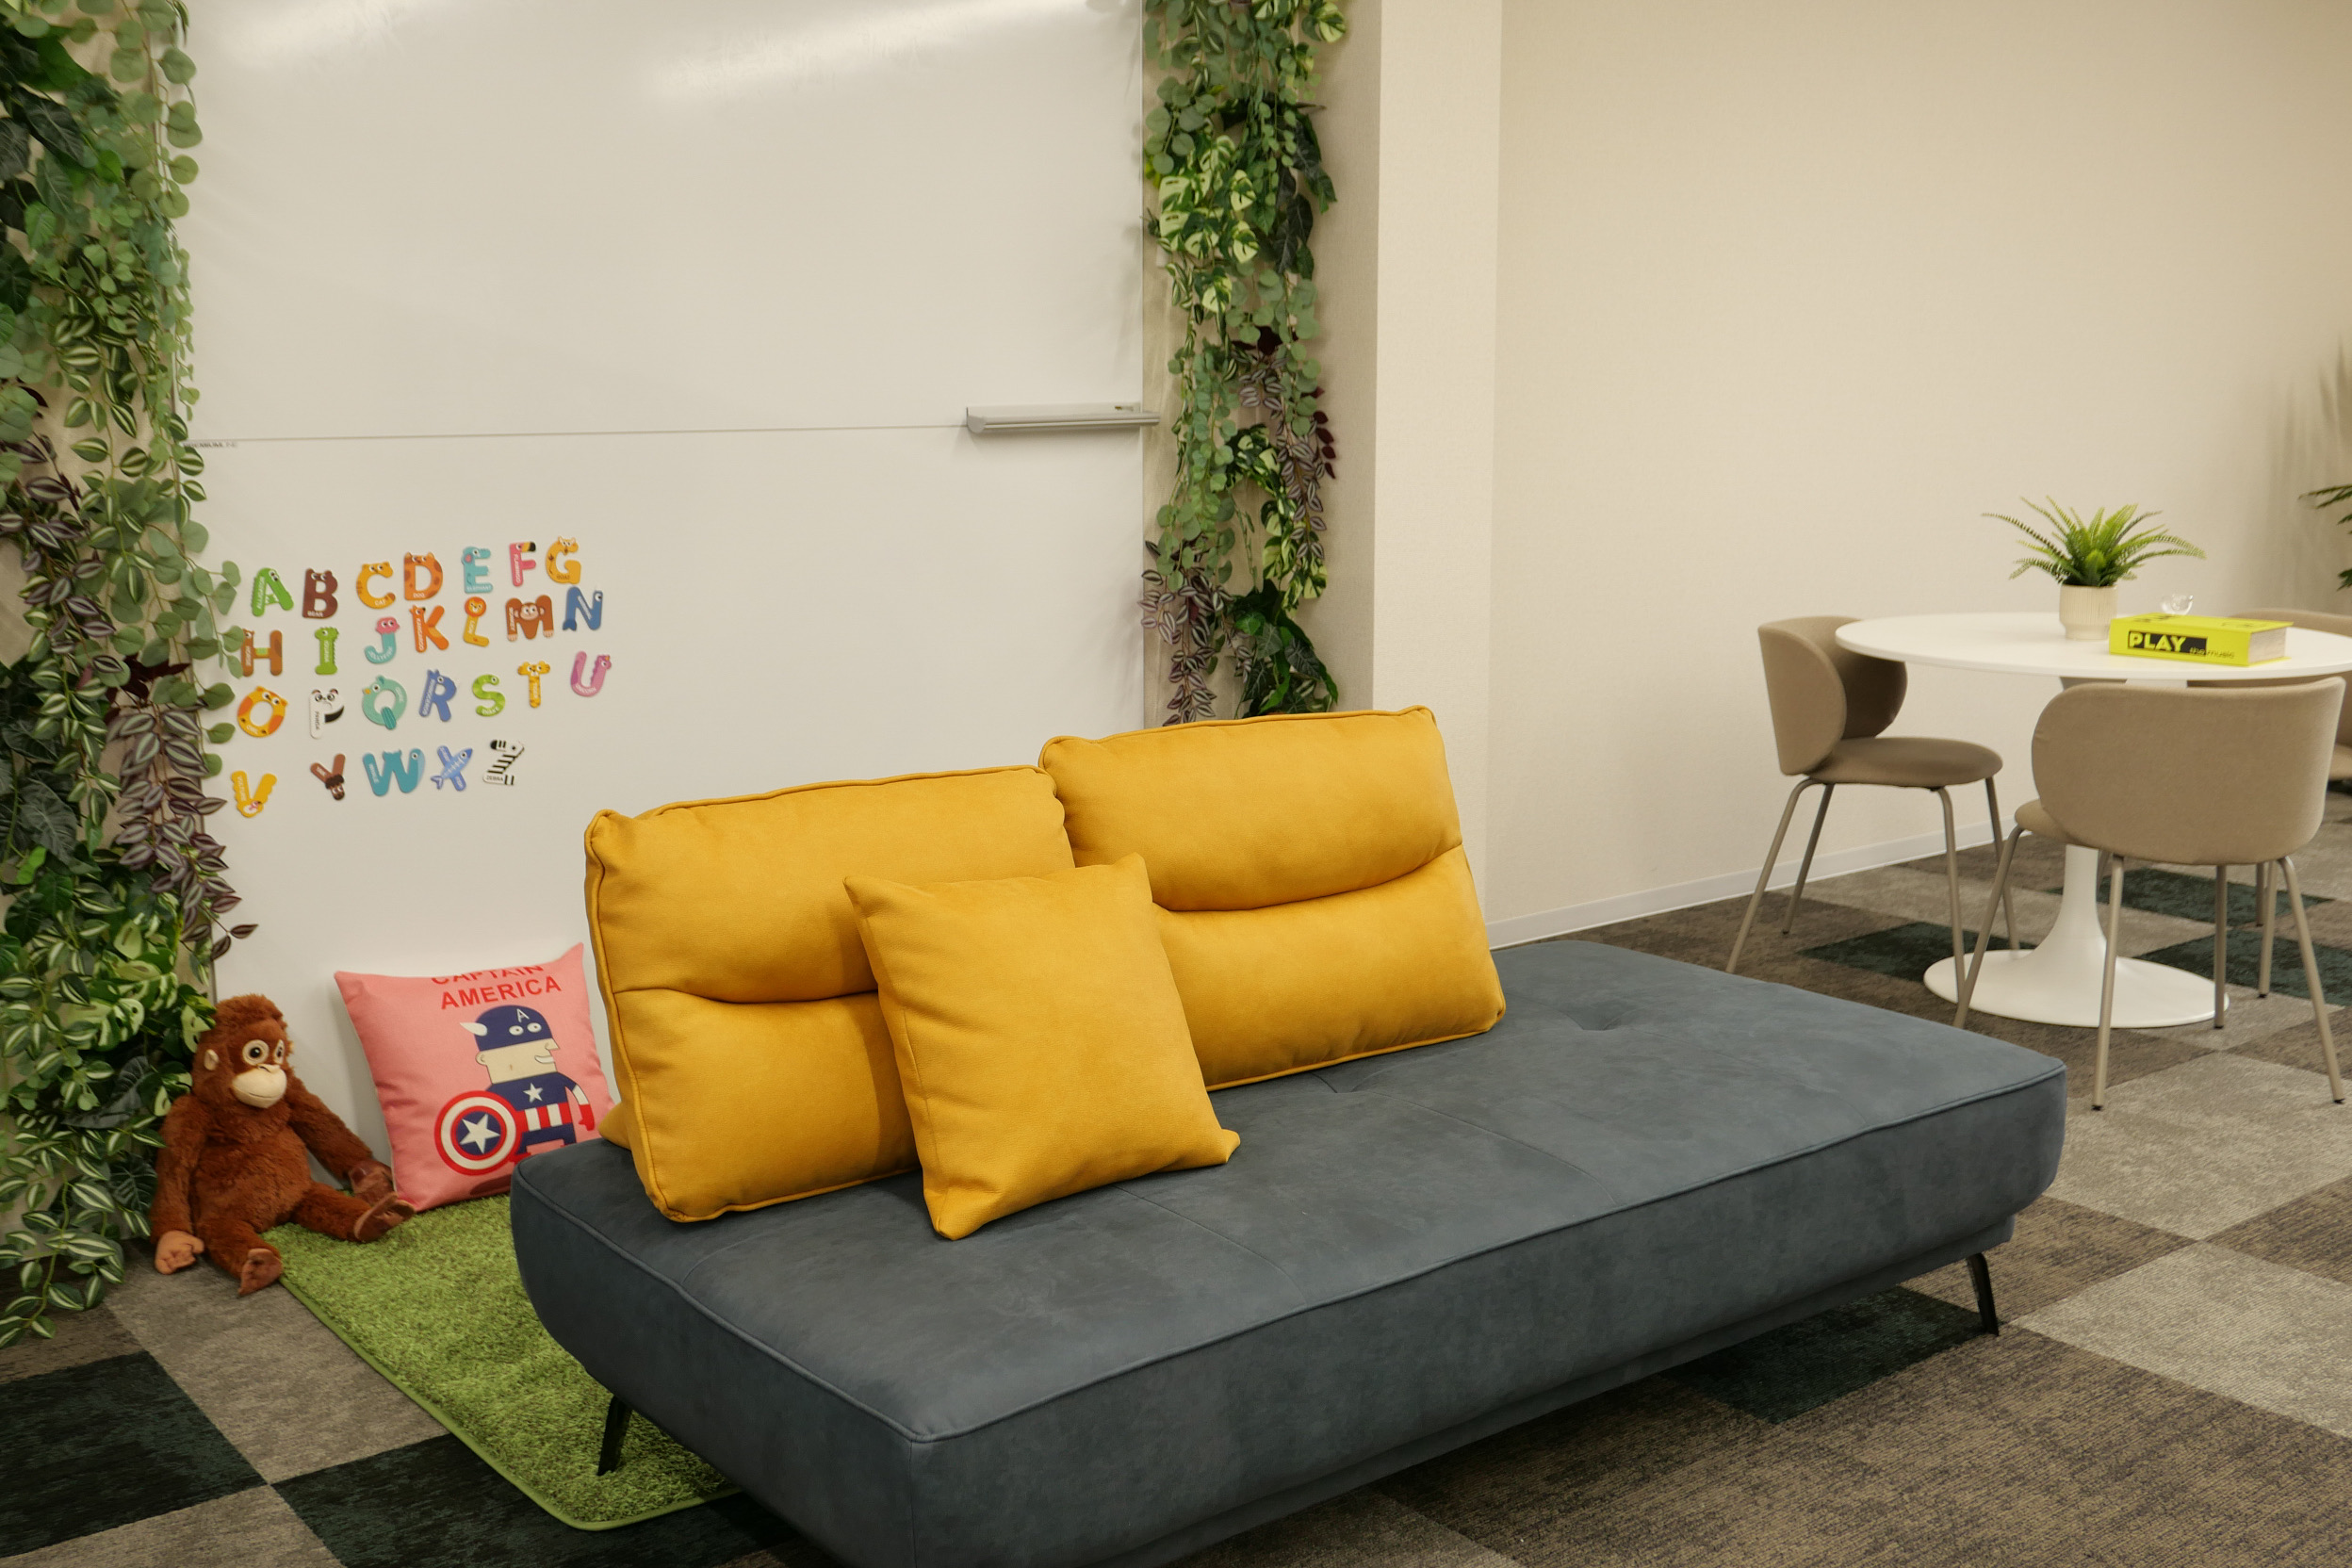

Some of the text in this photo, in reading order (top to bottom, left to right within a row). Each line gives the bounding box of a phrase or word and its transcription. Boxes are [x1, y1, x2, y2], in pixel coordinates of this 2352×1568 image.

[251, 536, 582, 620] A B C D E F G
[241, 585, 604, 678] H I J K L M N
[2129, 630, 2187, 652] PLAY
[237, 686, 288, 738] O
[362, 676, 407, 730] Q
[419, 669, 458, 722] R
[471, 674, 506, 717] S
[517, 661, 551, 709] T
[570, 650, 612, 697] U
[231, 770, 278, 818] V
[310, 754, 346, 801] Y
[363, 748, 425, 796] W
[431, 745, 473, 792] X
[441, 975, 563, 1010] AMERICA
[516, 1007, 530, 1022] A
